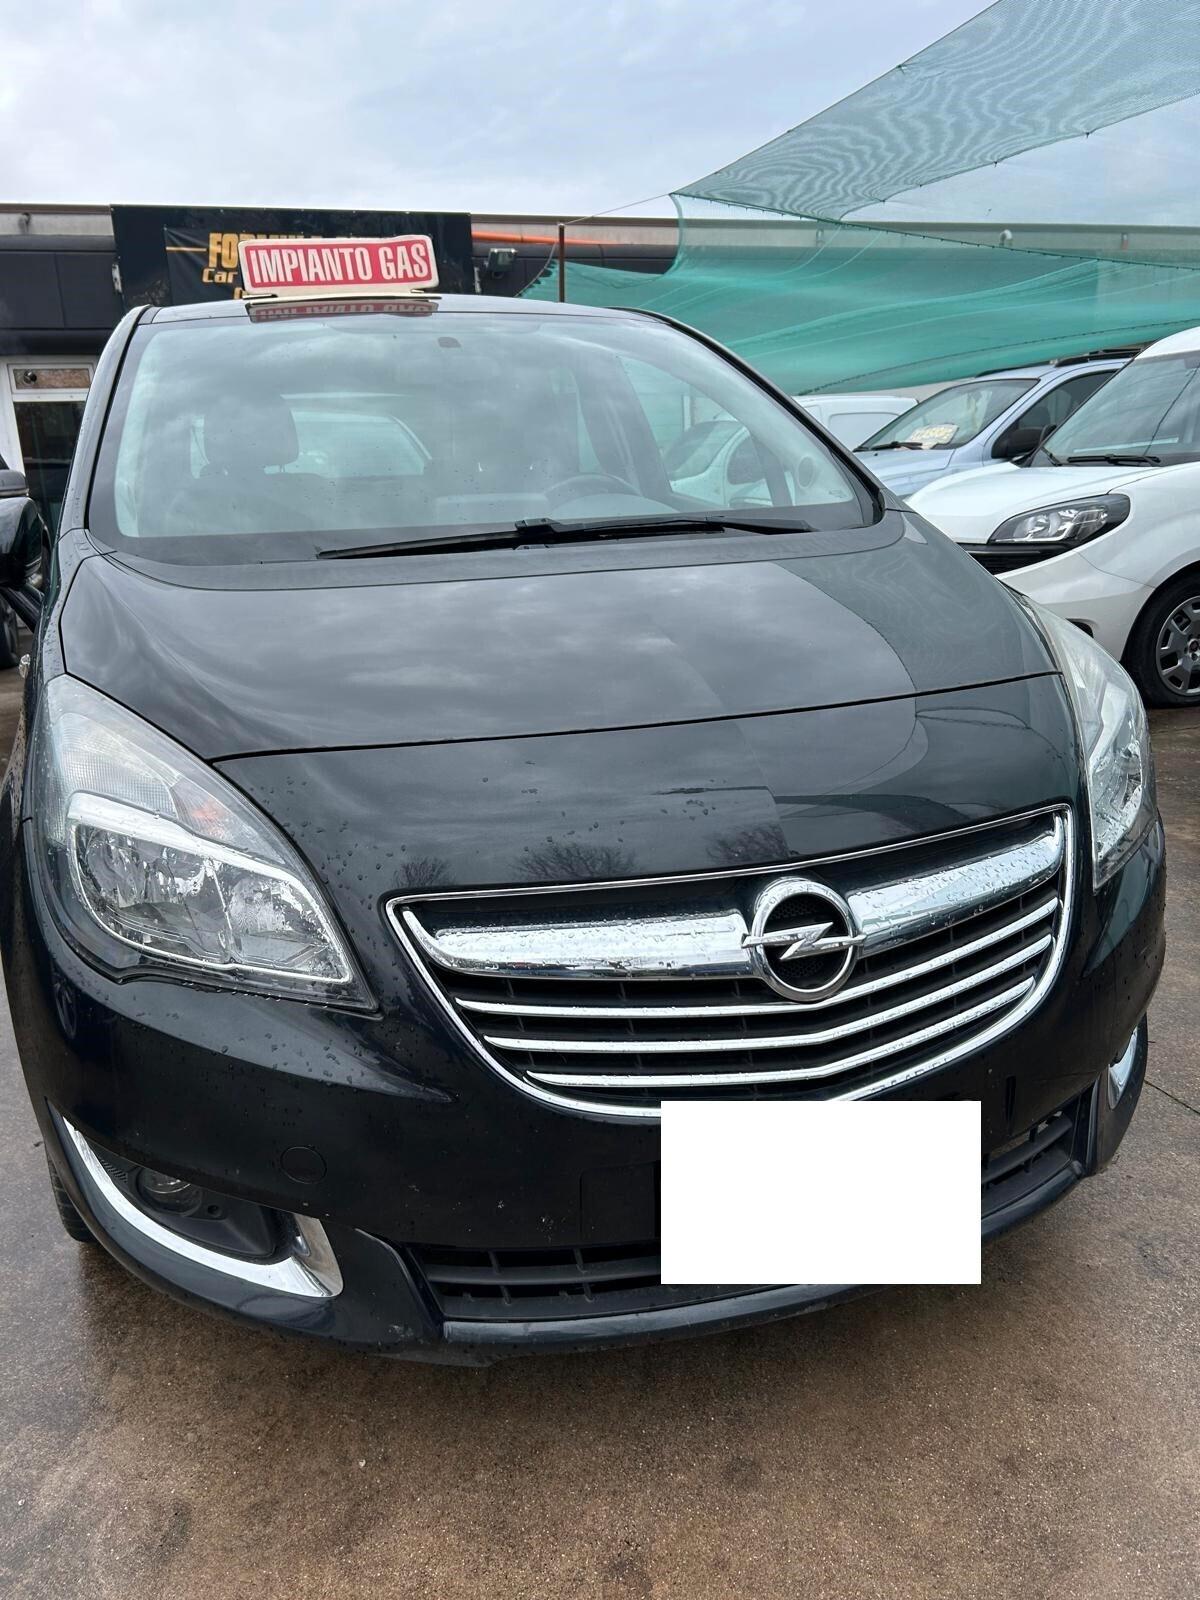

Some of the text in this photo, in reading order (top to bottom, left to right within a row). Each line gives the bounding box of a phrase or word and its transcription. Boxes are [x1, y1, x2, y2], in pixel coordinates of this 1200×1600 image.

[202, 268, 238, 283] Car
[250, 246, 373, 283] IMPIANTO
[378, 243, 429, 281] GAS
